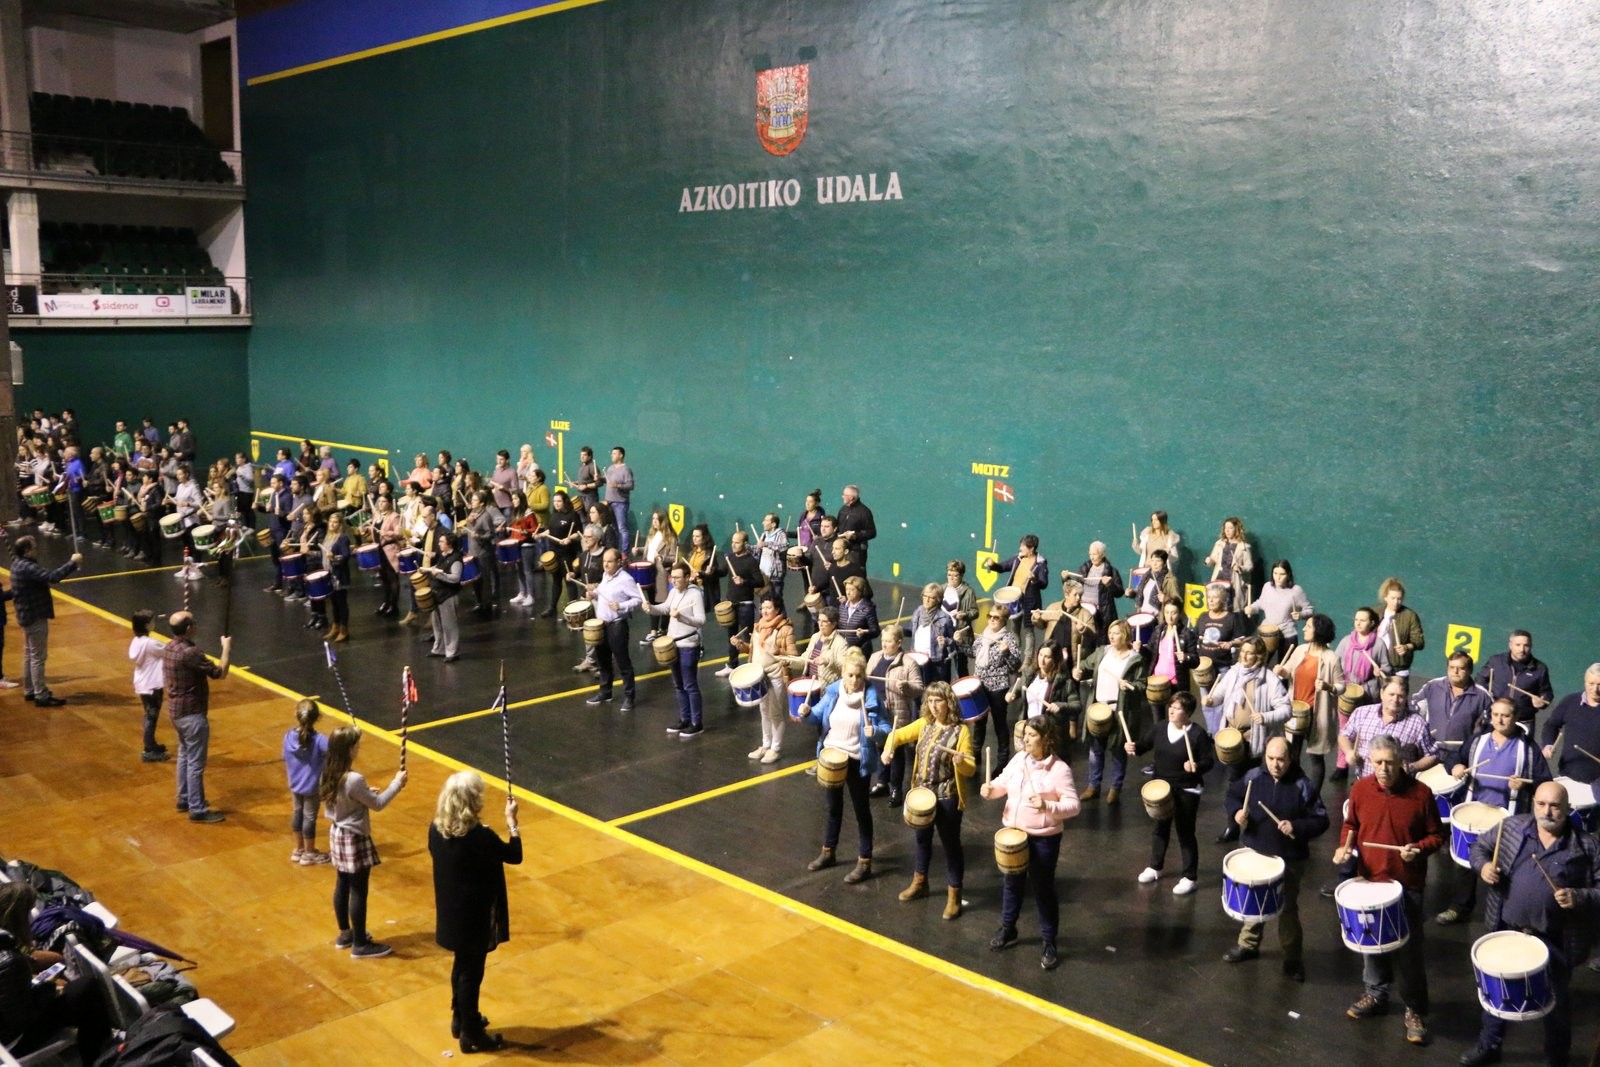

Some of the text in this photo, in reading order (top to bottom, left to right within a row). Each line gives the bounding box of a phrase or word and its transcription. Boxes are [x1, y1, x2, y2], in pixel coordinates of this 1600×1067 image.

[678, 171, 904, 213] AZKOITIKO UDALA
[200, 289, 226, 298] MILAR
[102, 301, 139, 309] sidenor
[971, 462, 1010, 478] MOTZ
[672, 508, 681, 523] 6
[1189, 590, 1205, 609] 3
[1453, 631, 1473, 654] 2
